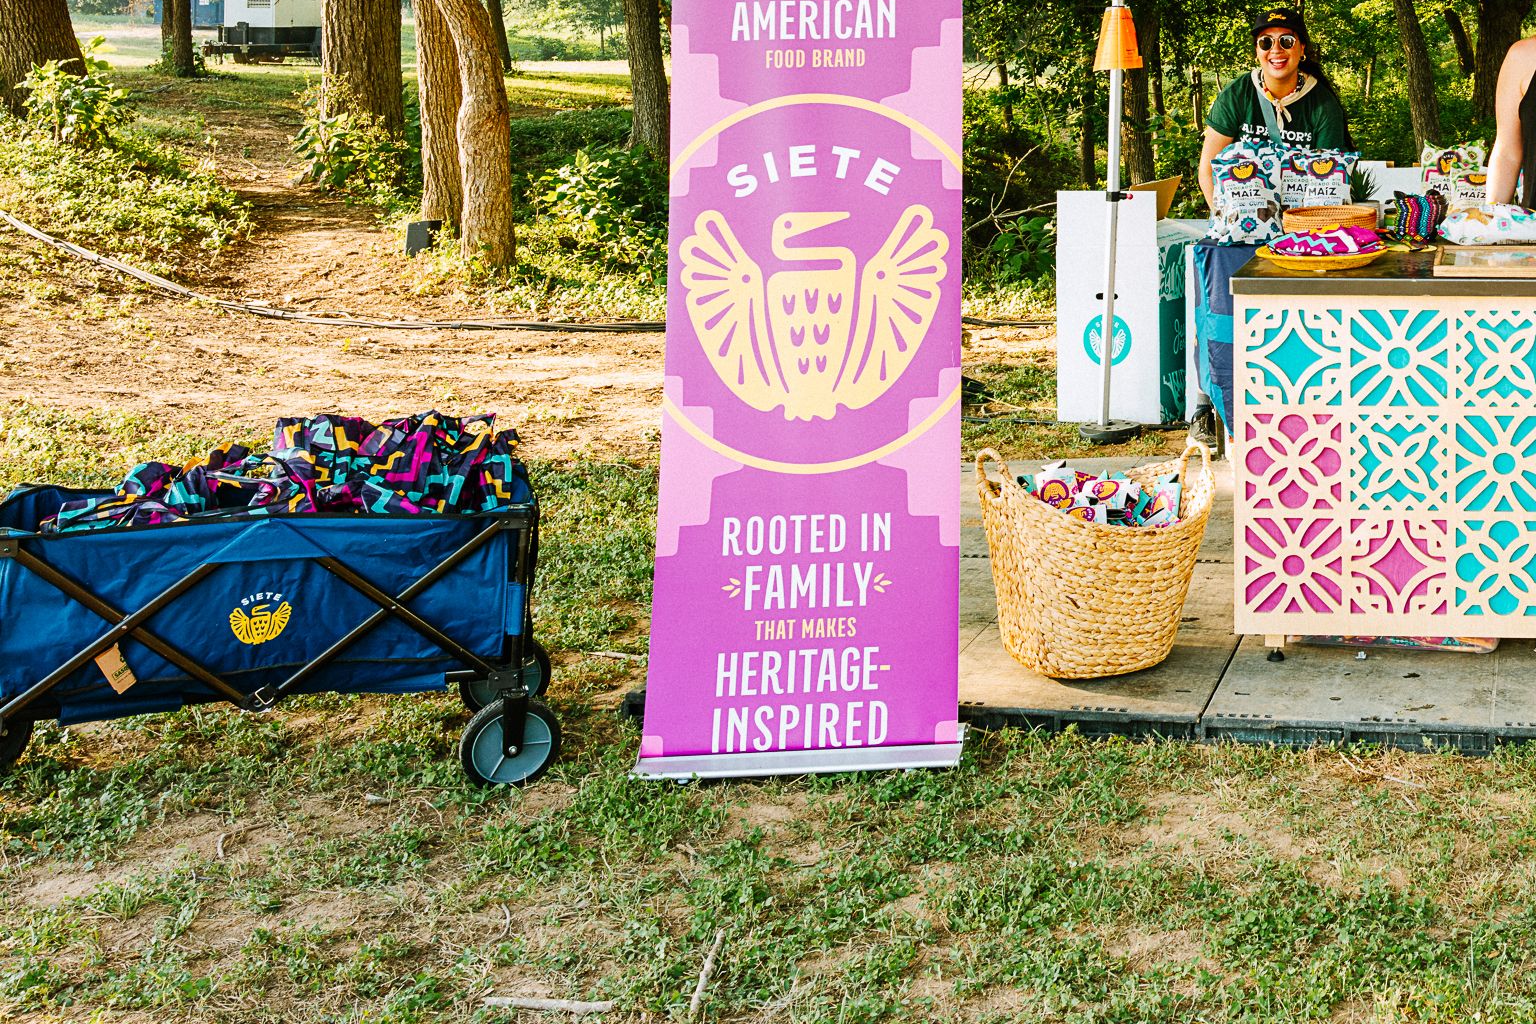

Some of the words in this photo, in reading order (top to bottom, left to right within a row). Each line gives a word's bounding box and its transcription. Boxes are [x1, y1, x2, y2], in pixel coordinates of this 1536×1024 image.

[766, 49, 805, 69] FOOD
[812, 48, 866, 68] BRAND
[726, 144, 901, 198] SIETE
[722, 513, 847, 557] ROOTED
[861, 512, 891, 553] IN
[241, 591, 283, 606] SIETE
[744, 561, 874, 611] FAMILY
[755, 619, 796, 641] THAT
[801, 617, 857, 640] MAKES
[715, 646, 891, 698] HERITAGE-
[711, 699, 889, 754] INSPIRED
